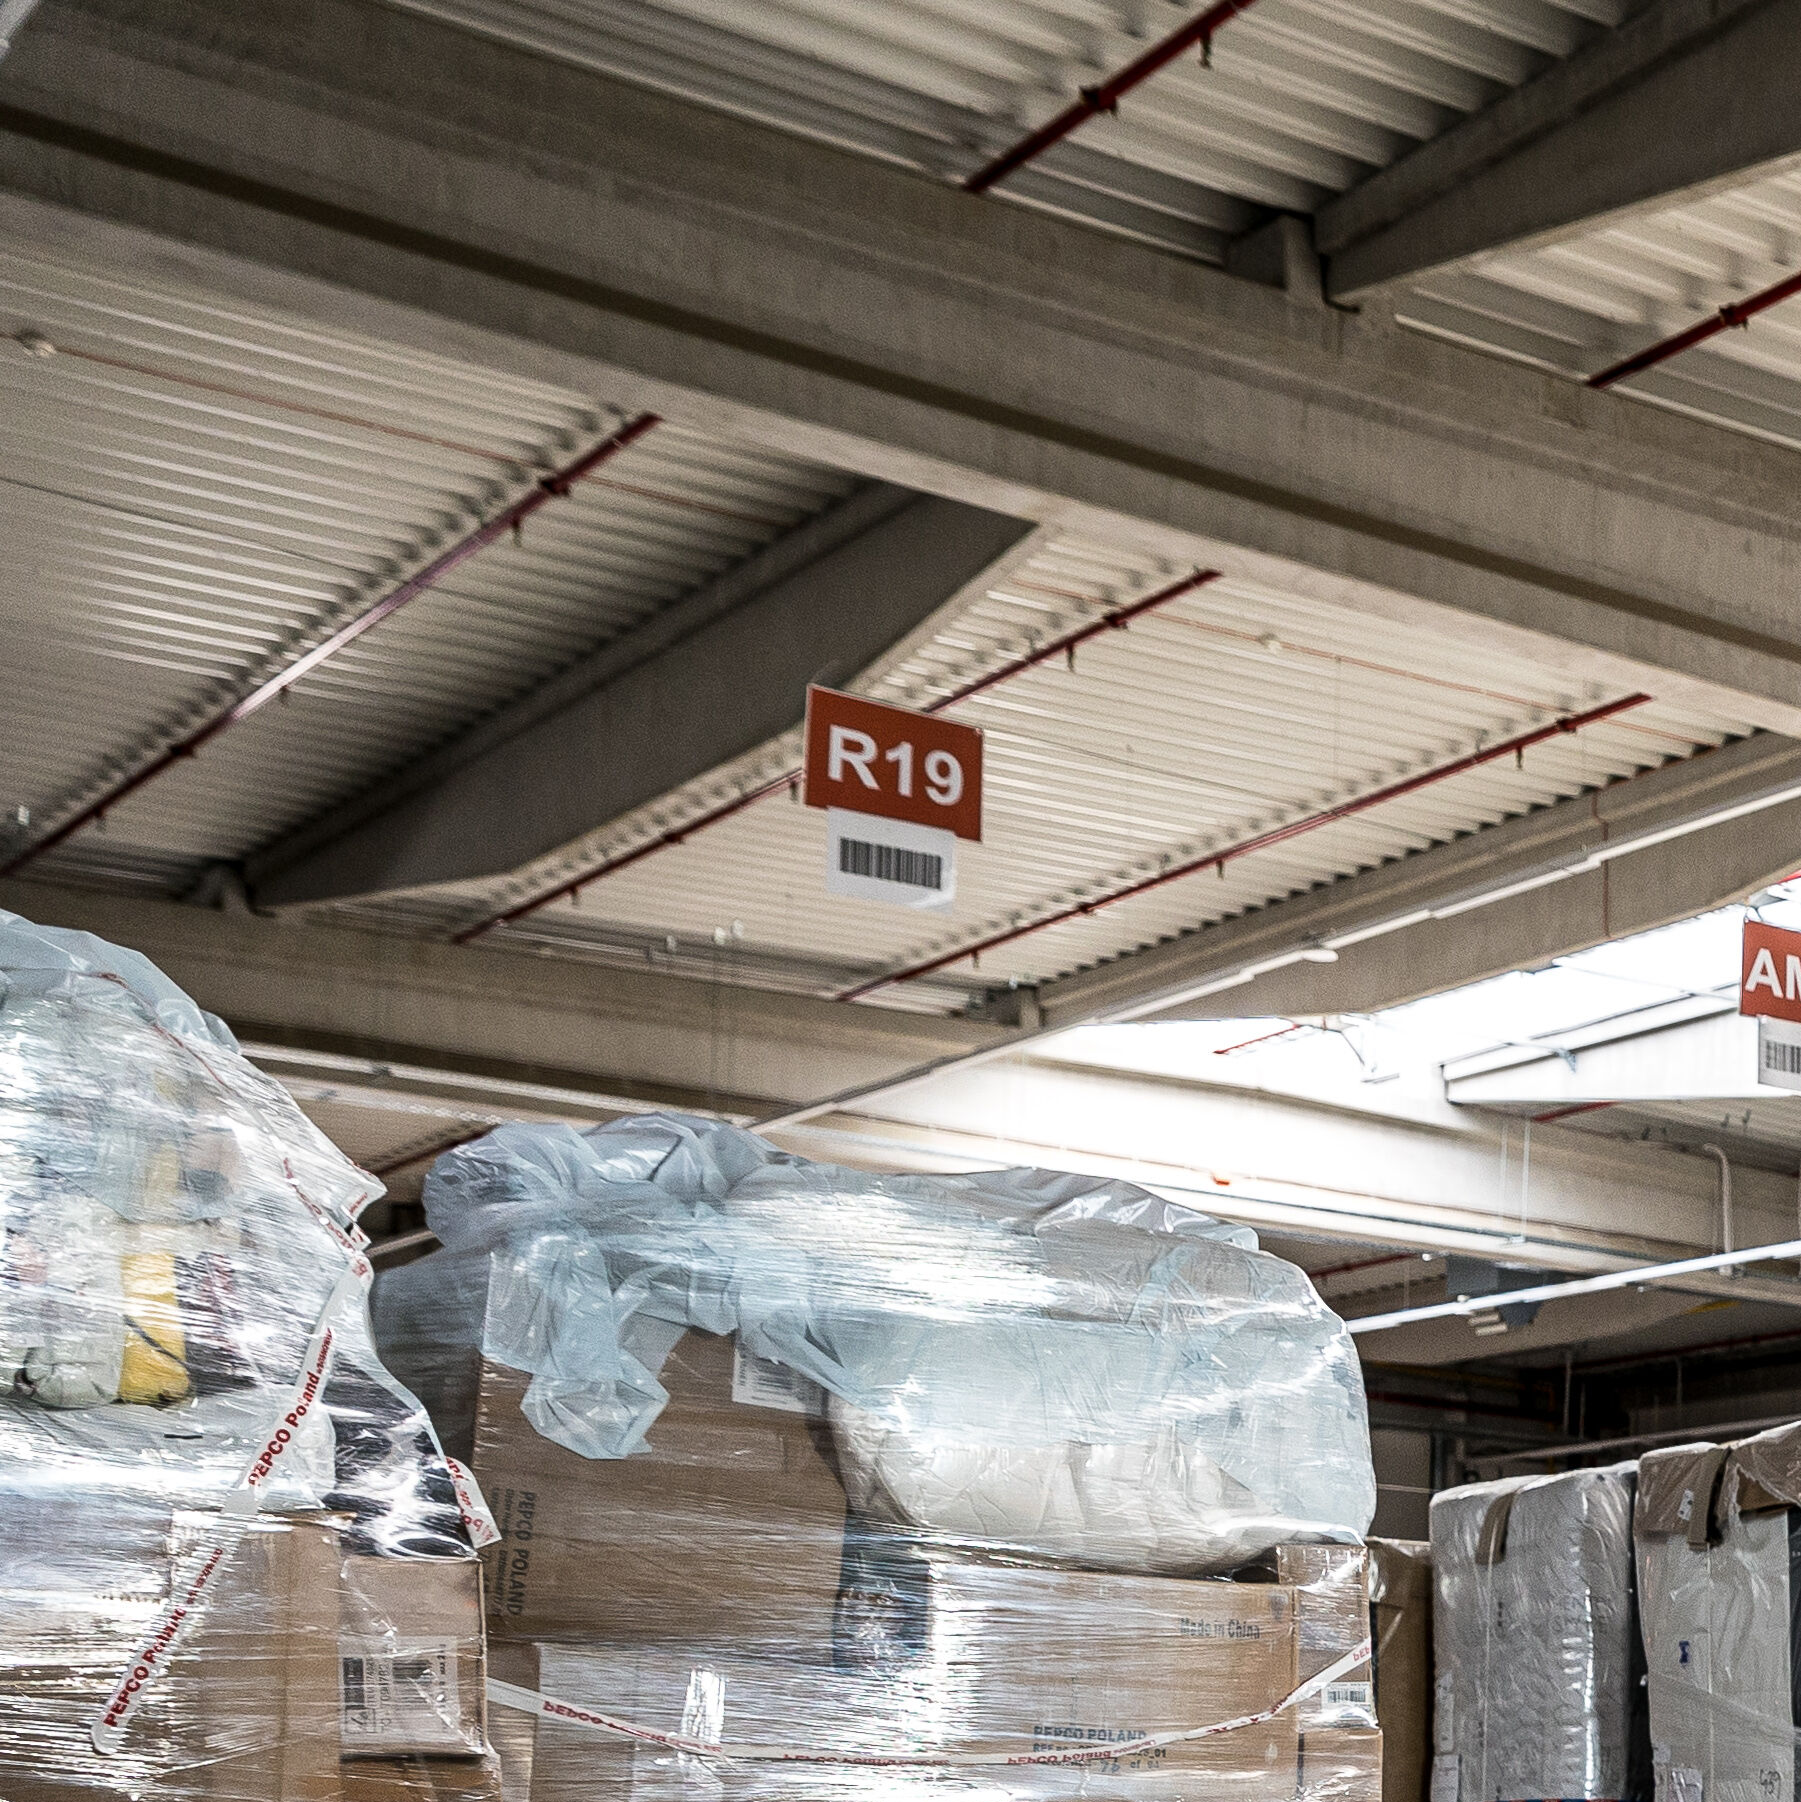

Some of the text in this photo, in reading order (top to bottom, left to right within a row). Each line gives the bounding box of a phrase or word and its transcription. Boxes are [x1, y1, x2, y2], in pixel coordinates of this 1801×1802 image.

[826, 725, 965, 807] R19
[248, 1428, 291, 1487] PEPCO
[286, 1371, 320, 1428] Poland
[507, 1491, 537, 1616] PEPCO POLAND
[1227, 1618, 1260, 1639] China
[103, 1666, 150, 1727] PEPCO
[1033, 1726, 1148, 1743] PEPCO POLAND
